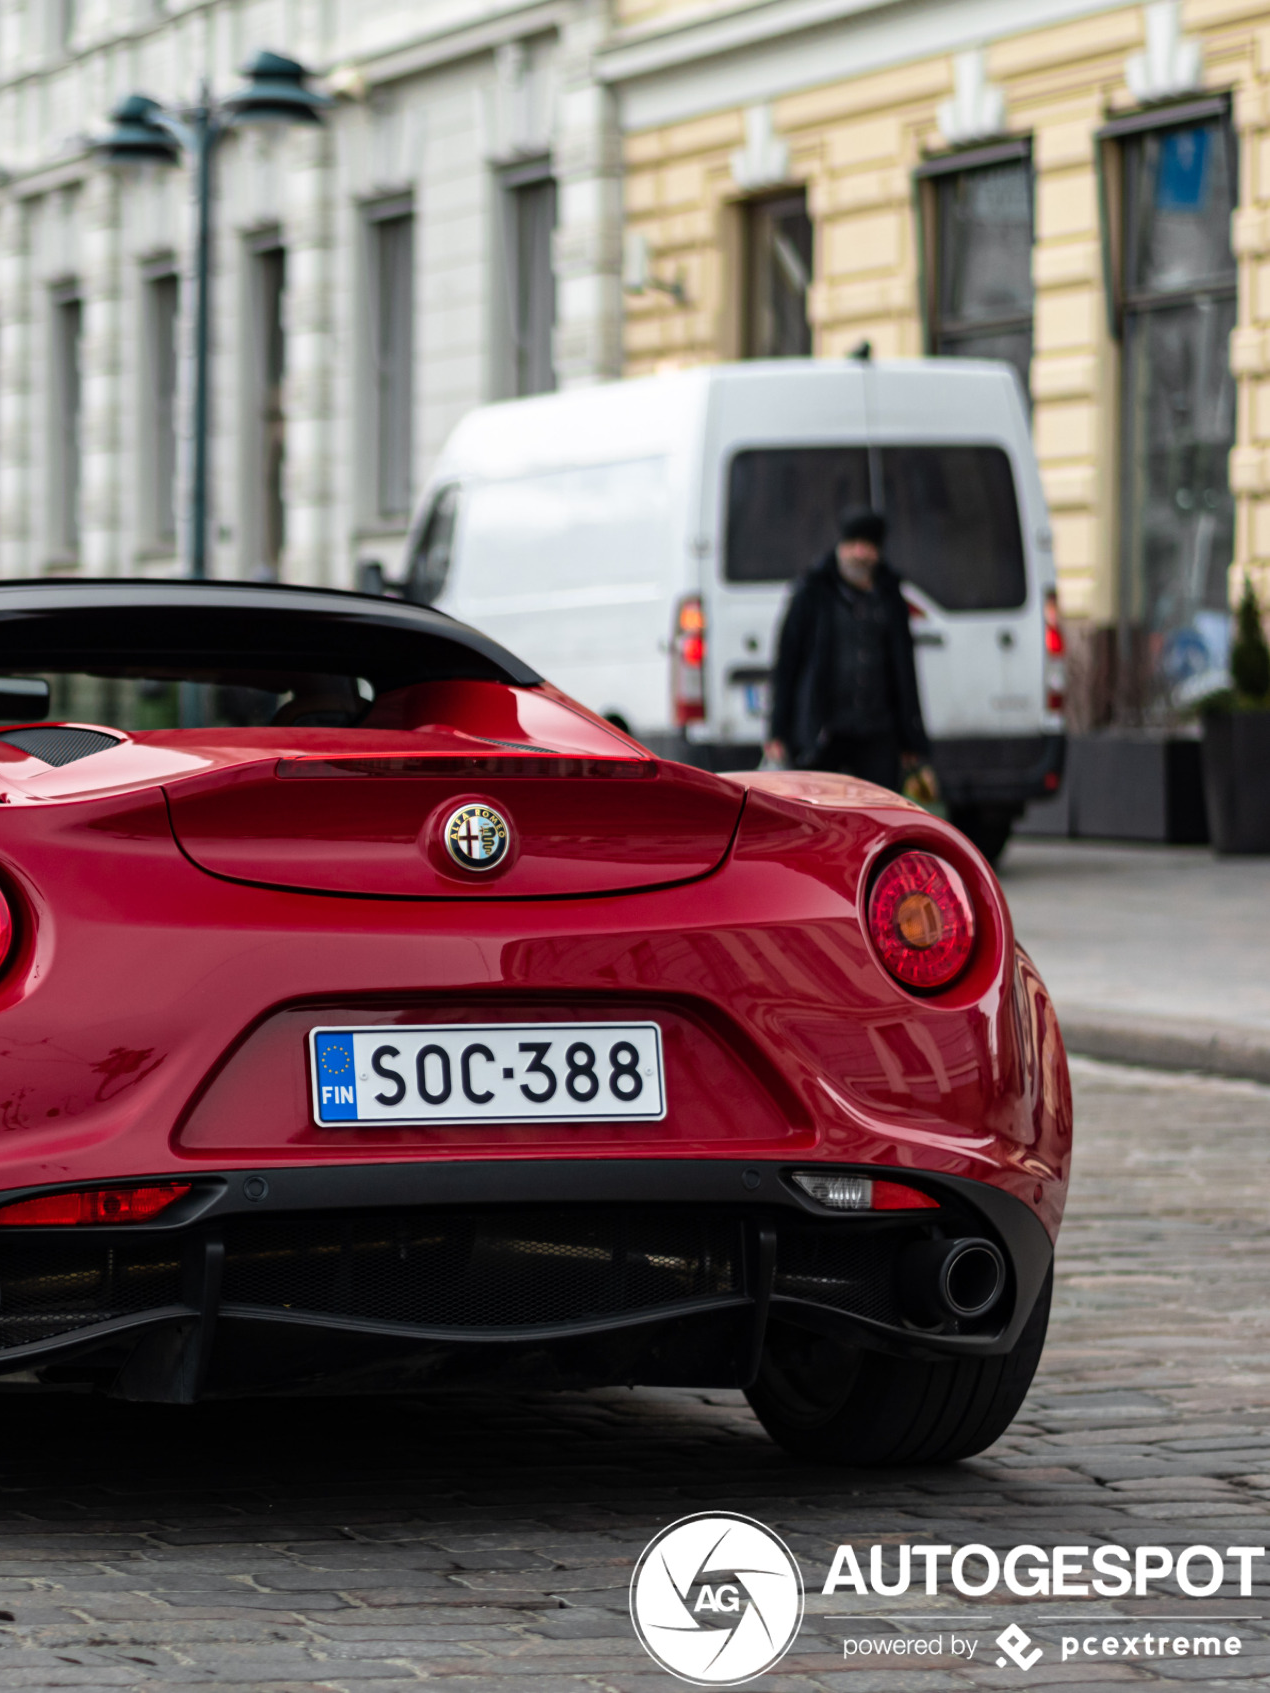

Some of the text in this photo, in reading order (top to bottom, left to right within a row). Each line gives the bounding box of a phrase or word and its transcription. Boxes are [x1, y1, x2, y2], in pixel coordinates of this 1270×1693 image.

[450, 809, 506, 840] ALFA ROMEO
[321, 1085, 355, 1105] FIN
